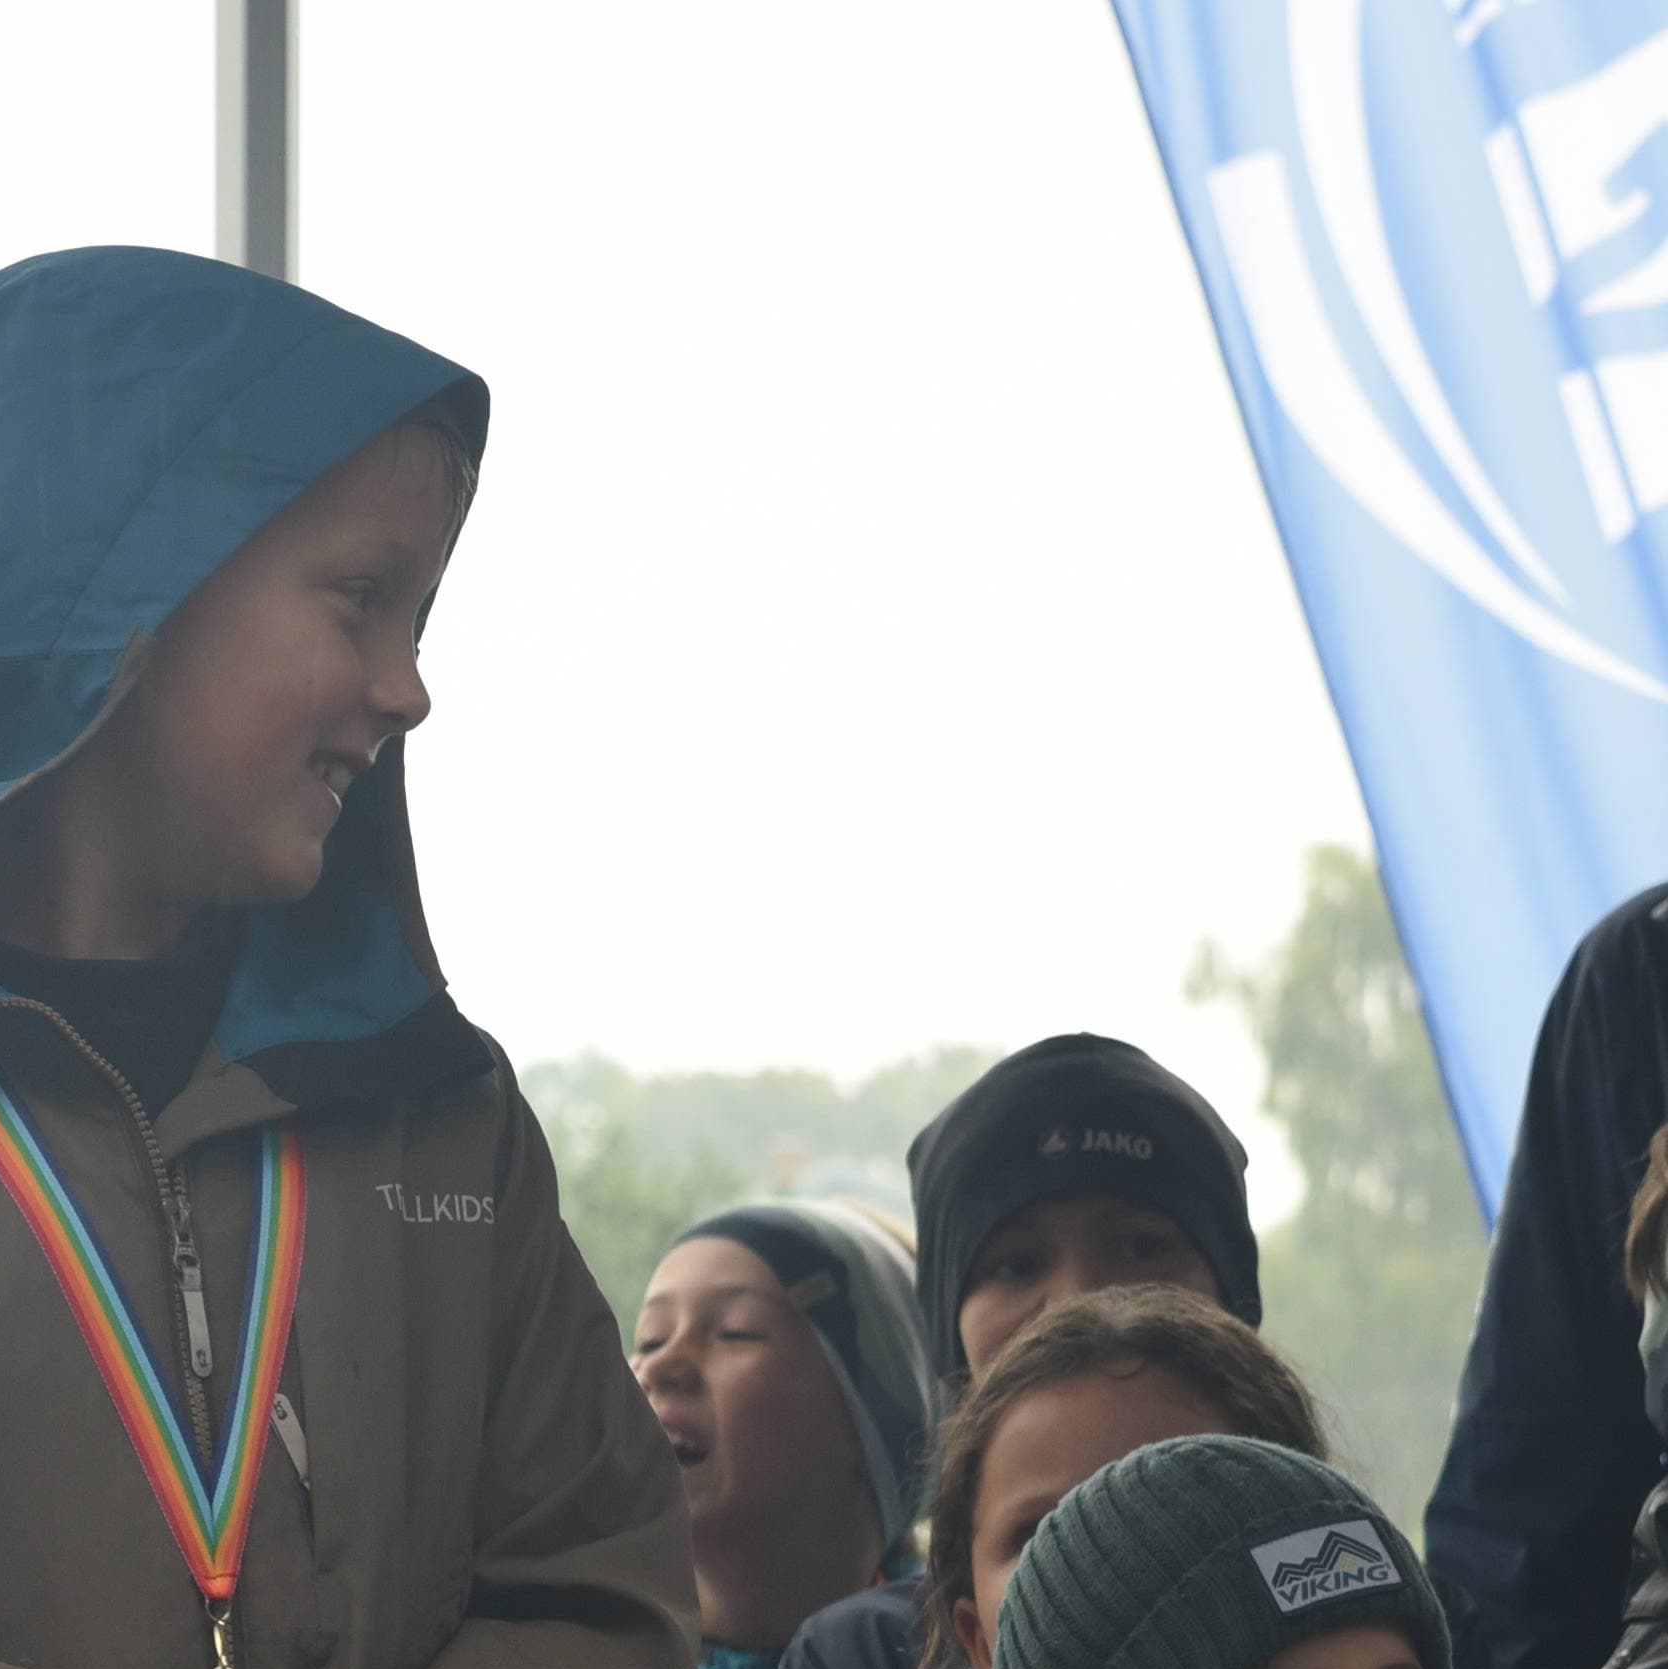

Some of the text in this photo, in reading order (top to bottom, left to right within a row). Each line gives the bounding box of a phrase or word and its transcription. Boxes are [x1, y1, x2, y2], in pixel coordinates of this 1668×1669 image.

[1081, 1128, 1154, 1160] JAKO
[375, 1183, 495, 1224] TLLKIDS
[1277, 1563, 1389, 1605] VIKING
